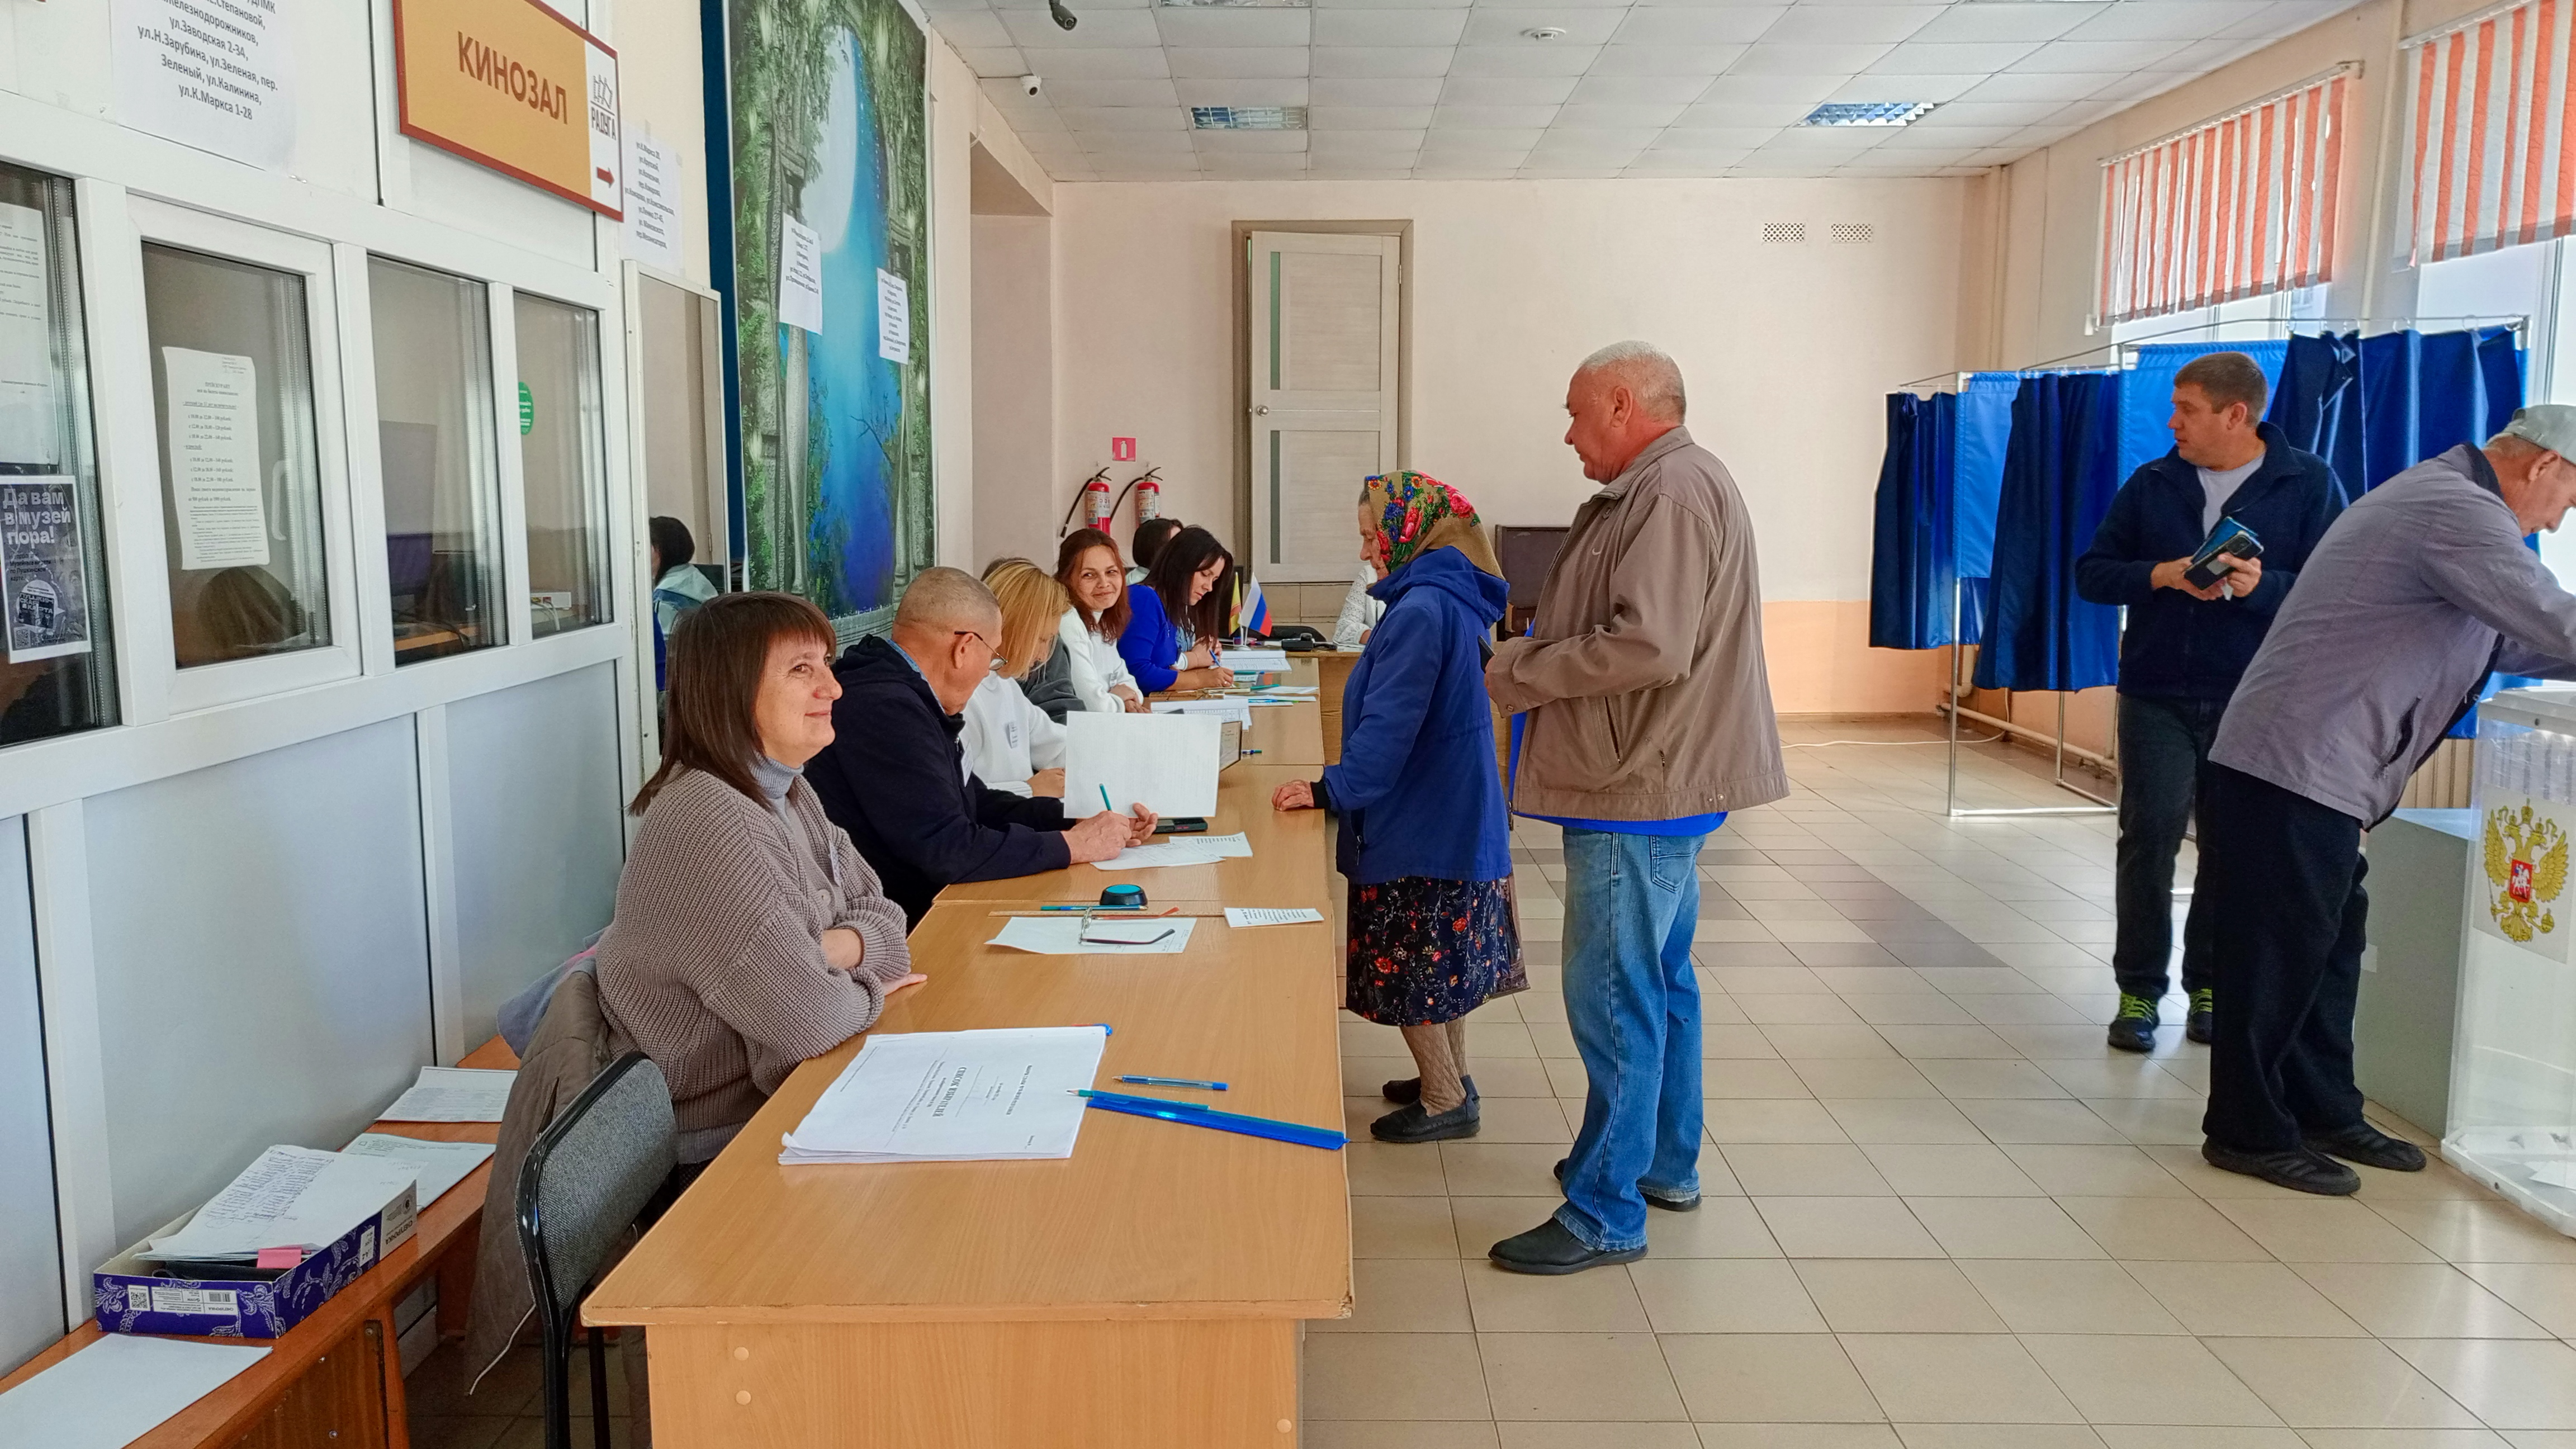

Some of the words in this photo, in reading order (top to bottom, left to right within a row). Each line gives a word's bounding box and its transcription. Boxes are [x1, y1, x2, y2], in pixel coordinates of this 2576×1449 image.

[169, 16, 226, 50] ул.Заводская
[227, 41, 248, 61] 2-34,
[138, 25, 209, 64] ул.Н.Зарубина,
[209, 54, 259, 85] ул.Зеленая,
[261, 76, 278, 91] пер.
[160, 54, 205, 83] Зеленый,
[206, 73, 262, 105] ул.Калинина,
[458, 31, 568, 125] КИНОЗАЛ
[178, 84, 234, 113] ул.К.Маркса
[235, 104, 253, 120] 1-28
[590, 106, 617, 141] РАДУГА
[3, 488, 29, 509] Да
[30, 491, 64, 505] вам
[4, 512, 15, 525] в
[18, 506, 71, 530] музей
[7, 525, 55, 549] пора!
[950, 1066, 968, 1087] СПИСОК
[932, 1087, 959, 1117] ИЗБИРАТЕЛЕЙ
